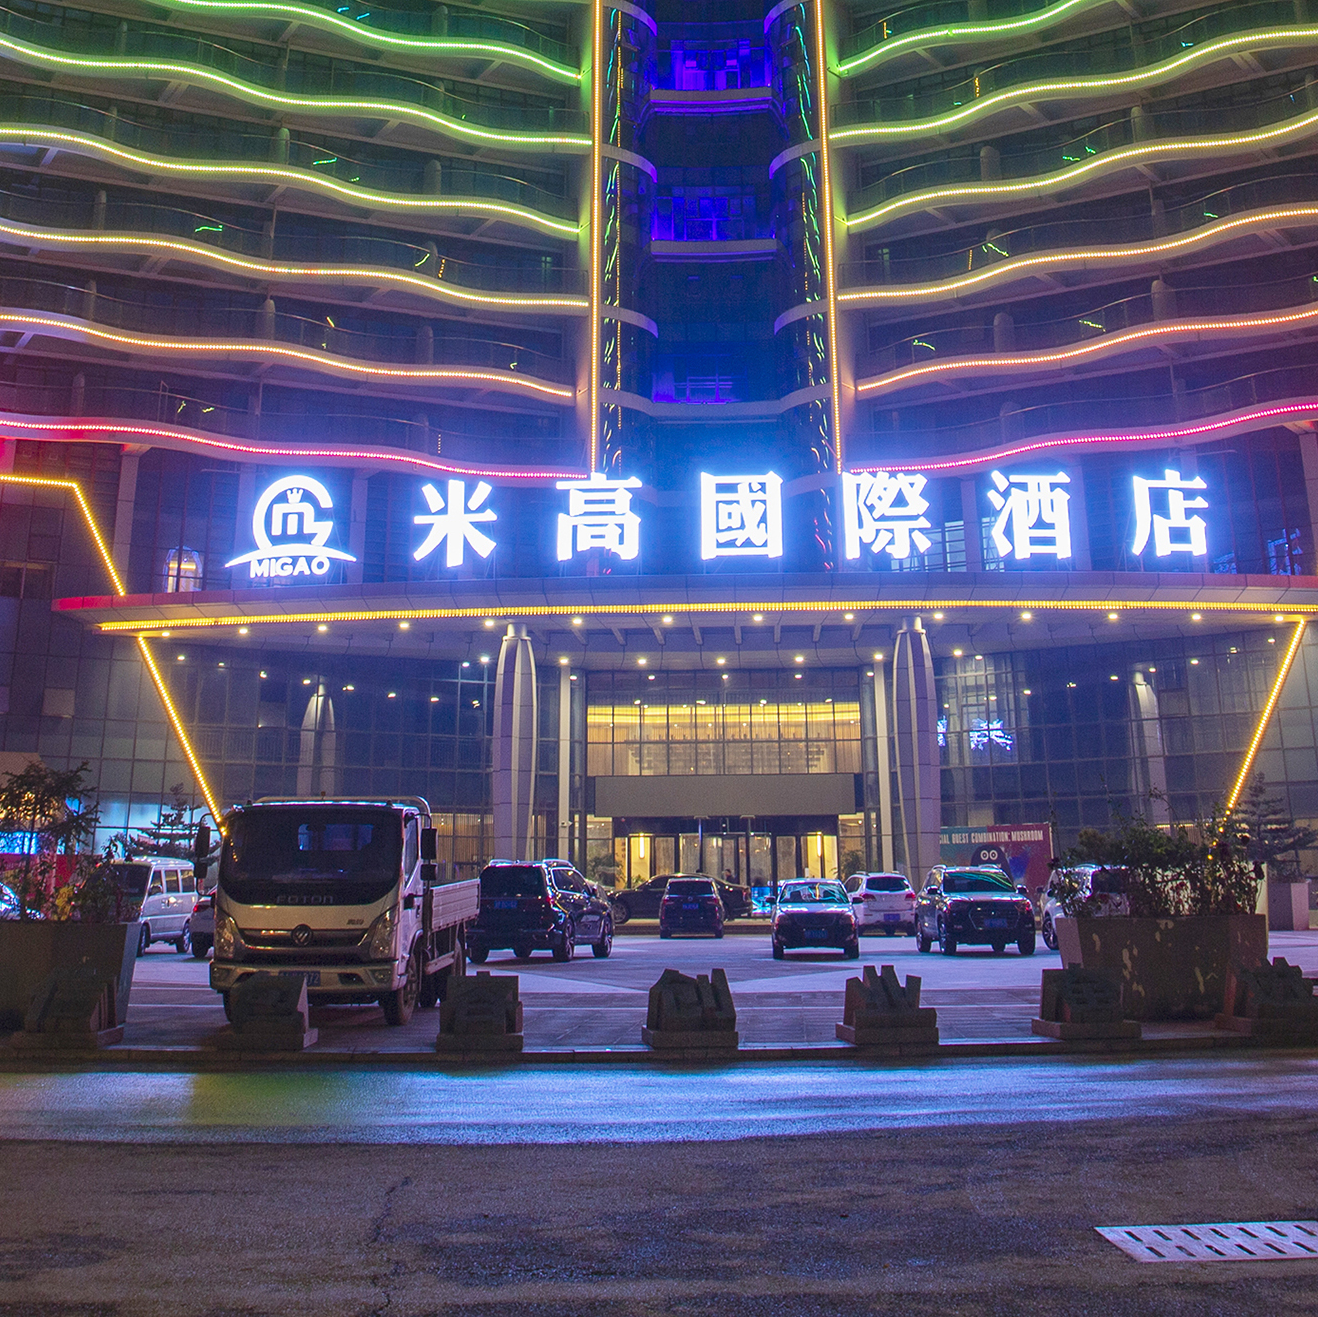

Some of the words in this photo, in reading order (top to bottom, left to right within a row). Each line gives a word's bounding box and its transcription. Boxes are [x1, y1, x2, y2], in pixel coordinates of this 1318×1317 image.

[413, 470, 1209, 568] 米高國際酒店
[250, 555, 330, 578] MIGAO
[952, 832, 970, 845] GUEST
[1011, 829, 1044, 842] MUSHROOM
[275, 895, 334, 905] FOTON
